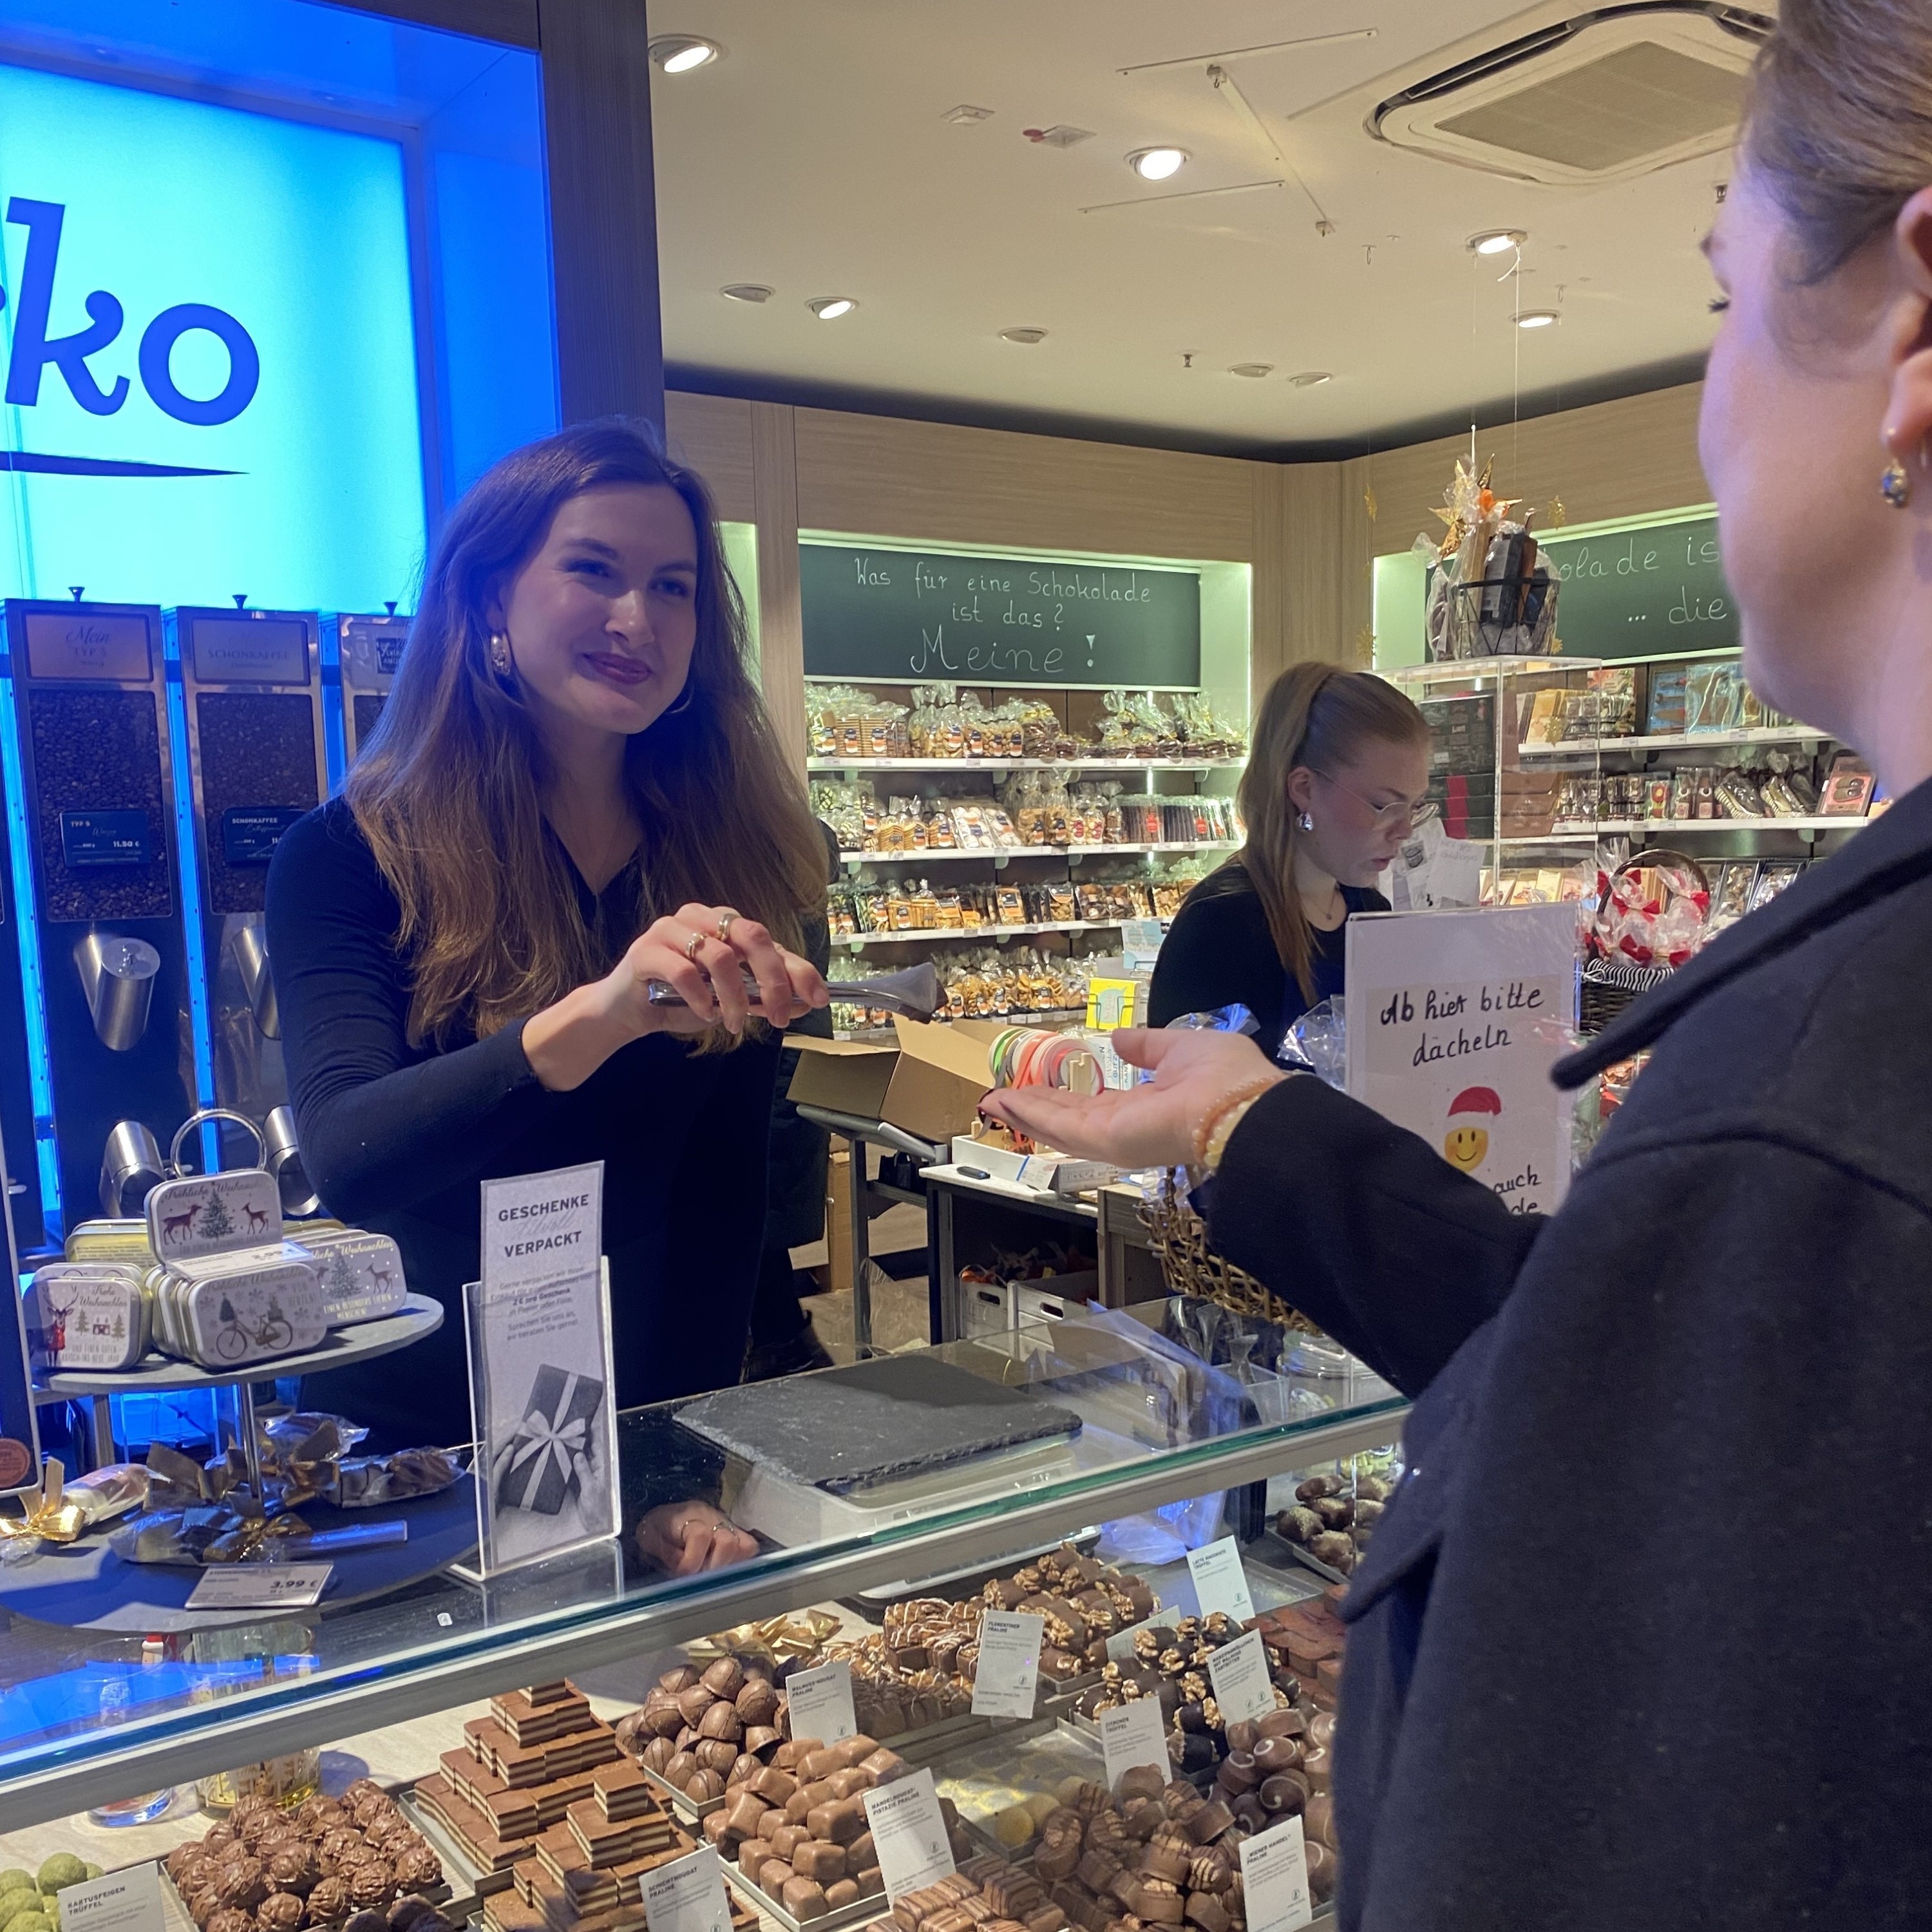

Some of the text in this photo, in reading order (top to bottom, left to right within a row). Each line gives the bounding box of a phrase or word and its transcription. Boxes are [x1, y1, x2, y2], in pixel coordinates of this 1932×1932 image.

[0, 196, 260, 426] ko
[1543, 536, 1719, 582] olade is
[855, 558, 1151, 602] Was für eine Schokolade
[952, 596, 983, 622] ist
[1669, 585, 1727, 624] die
[66, 625, 109, 644] Mein
[208, 649, 290, 660] SCHONKAFFEE
[910, 624, 1064, 673] Meine
[1380, 983, 1545, 1025] Ab hier bitte
[1493, 1164, 1542, 1194] auch
[498, 1194, 589, 1222] GESCHENKE
[1511, 1197, 1542, 1213] de
[312, 1239, 393, 1259] liche Weihnachten
[505, 1231, 582, 1258] VERPACKT
[80, 1296, 127, 1307] Weihnachten
[93, 1285, 115, 1296] Frohe
[525, 1296, 537, 1304] pro
[539, 1288, 571, 1300] Geschenk
[508, 1318, 539, 1332] Sprechen
[1106, 1716, 1129, 1727] ZITRONEN
[873, 1792, 920, 1815] PISTAZIE PRALINE
[649, 1866, 697, 1891] SCHICHTNOUGAT
[650, 1884, 675, 1899] PRALINE
[70, 1900, 103, 1916] TRÜFFEL
